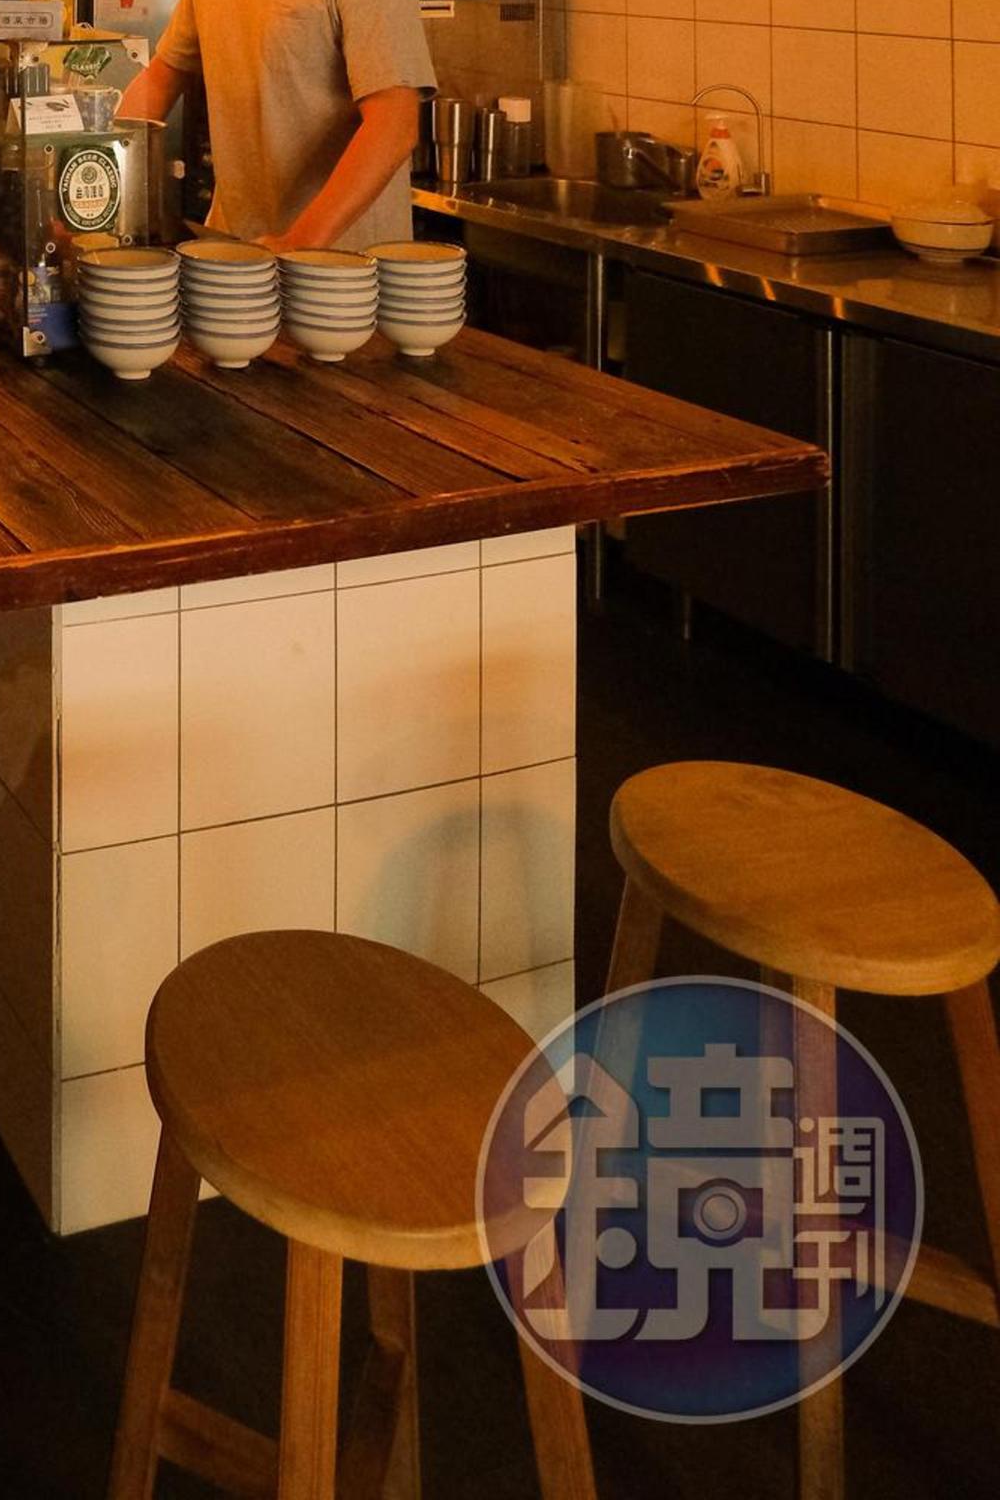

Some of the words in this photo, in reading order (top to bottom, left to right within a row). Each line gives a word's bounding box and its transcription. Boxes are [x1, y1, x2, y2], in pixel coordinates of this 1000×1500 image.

[62, 161, 78, 192] TAIWAN
[77, 154, 98, 164] BEER
[98, 157, 117, 189] CLASSIC
